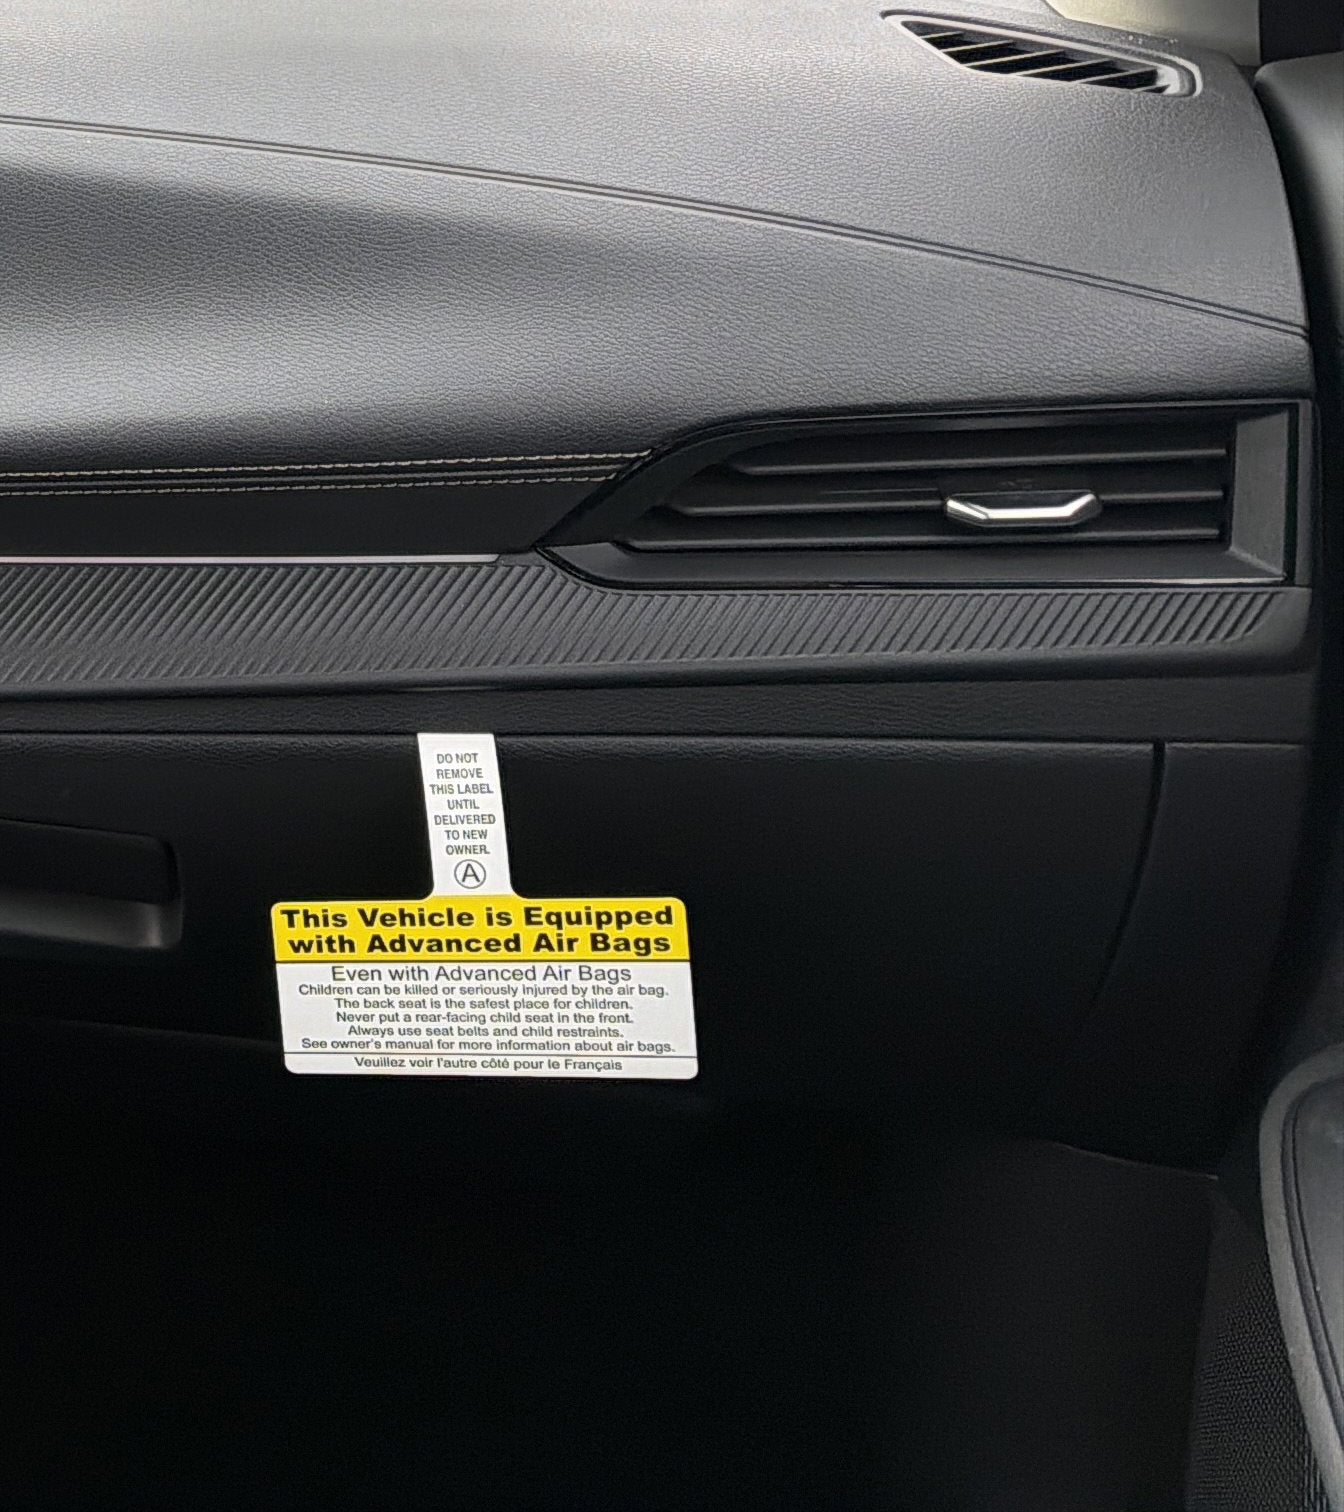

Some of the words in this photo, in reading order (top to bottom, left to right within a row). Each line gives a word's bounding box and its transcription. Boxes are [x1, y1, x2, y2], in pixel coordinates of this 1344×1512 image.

[436, 752, 453, 764] DO
[454, 752, 478, 763] NOT
[435, 766, 483, 779] REMOVE
[428, 783, 454, 795] THIS
[456, 782, 494, 794] LABEL
[446, 798, 480, 810] UNTIL
[433, 813, 496, 825] DELIVERED
[444, 829, 460, 840] TO
[462, 828, 488, 840] NEW
[444, 843, 490, 855] OWNER.
[461, 862, 481, 883] A
[279, 908, 348, 928] This
[356, 907, 474, 927] Vehicle
[485, 906, 512, 926] is
[523, 904, 673, 930] Equipped
[287, 934, 355, 953] with
[366, 932, 521, 953] Advanced
[532, 932, 579, 952] Air
[589, 932, 670, 957] Bags
[330, 965, 382, 981] Even
[387, 964, 429, 981] with
[434, 964, 536, 981] Advanced
[542, 964, 572, 981] Air
[578, 964, 632, 985] Bags
[298, 983, 353, 995] Children
[356, 986, 380, 995] can
[383, 983, 400, 995] be
[403, 983, 438, 995] killed
[441, 986, 456, 995] or
[458, 983, 518, 997] seriously
[521, 983, 568, 998] injured
[570, 983, 588, 998] by
[590, 983, 613, 995] the
[616, 983, 635, 995] air
[637, 983, 668, 998] bag.
[333, 996, 360, 1008] The
[362, 997, 395, 1009] back
[397, 997, 427, 1009] seat
[429, 997, 441, 1009] is
[444, 997, 466, 1009] the
[468, 997, 510, 1009] safest
[512, 997, 549, 1011] place
[552, 997, 572, 1009] for
[574, 997, 633, 1010] children.
[335, 1010, 375, 1022] Never
[378, 1011, 400, 1025] put
[402, 1013, 412, 1022] a
[414, 1011, 486, 1025] rear-facing
[489, 1011, 521, 1023] child
[524, 1012, 554, 1023] seat
[556, 1011, 570, 1023] in
[572, 1011, 595, 1023] the
[598, 1011, 634, 1023] front.
[347, 1024, 394, 1038] Always
[397, 1027, 422, 1036] use
[424, 1025, 454, 1036] seat
[456, 1025, 489, 1036] belts
[492, 1025, 518, 1037] and
[520, 1025, 553, 1037] child
[556, 1025, 624, 1038] restraints.
[300, 1037, 328, 1049] See
[330, 1037, 382, 1049] owner's
[384, 1038, 433, 1049] manual
[436, 1038, 455, 1049] for
[458, 1041, 492, 1050] more
[495, 1038, 570, 1051] information
[574, 1039, 613, 1051] about
[616, 1039, 634, 1051] air
[636, 1040, 675, 1055] bags.
[353, 1056, 406, 1067] Veuillez
[408, 1056, 433, 1068] voir
[436, 1056, 477, 1068] l'autre
[480, 1057, 510, 1069] côté
[512, 1060, 544, 1071] pour
[546, 1058, 560, 1069] le
[564, 1058, 622, 1072] Français
